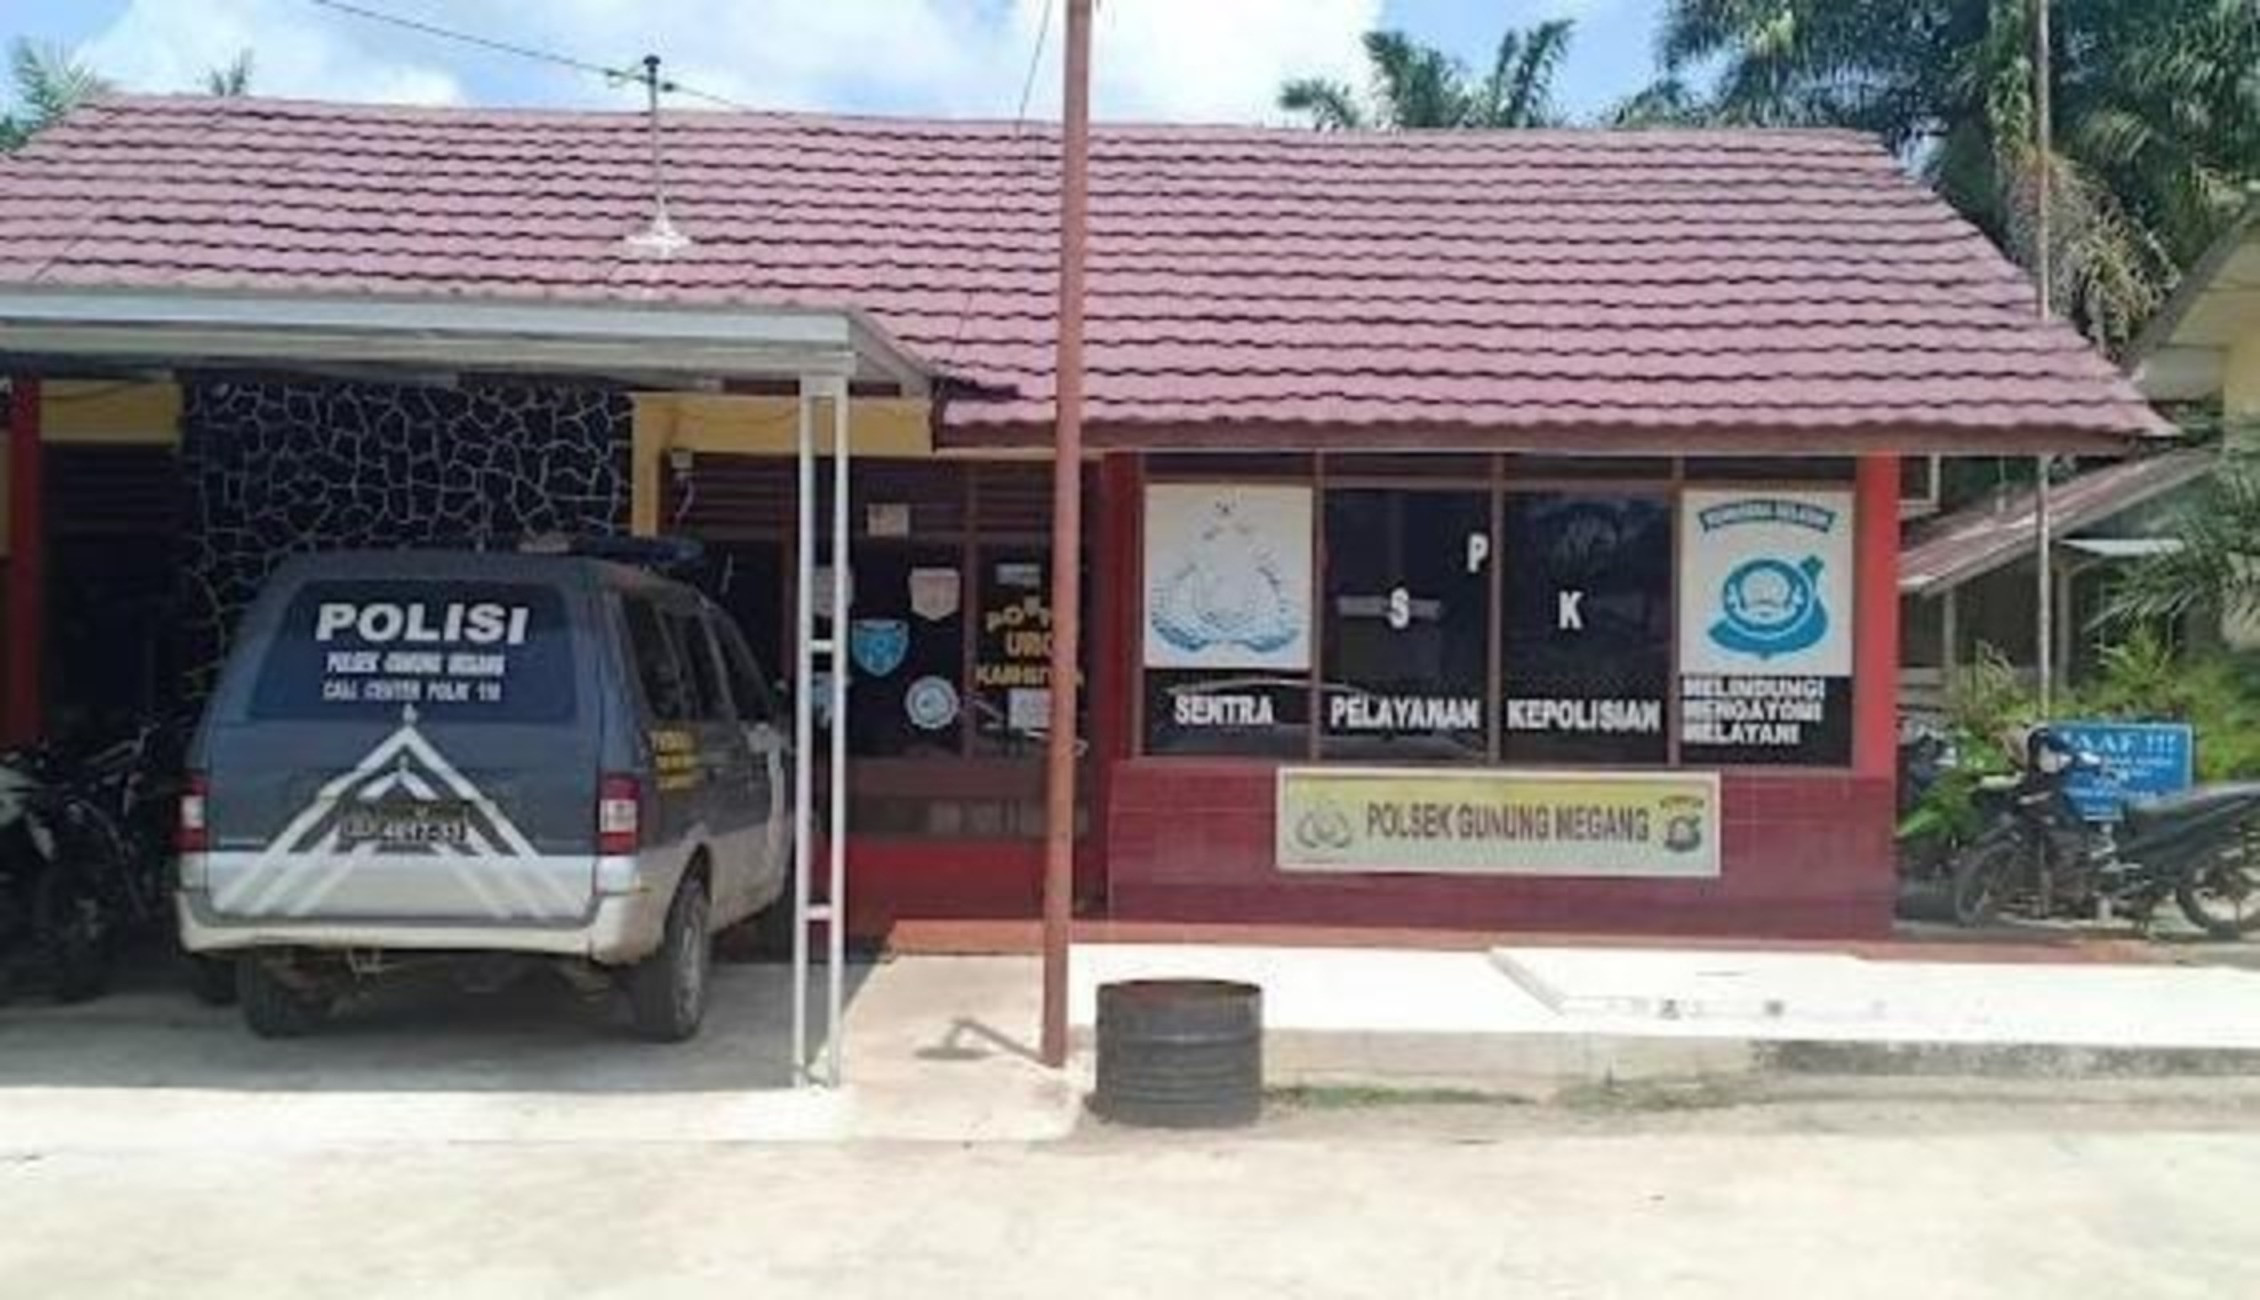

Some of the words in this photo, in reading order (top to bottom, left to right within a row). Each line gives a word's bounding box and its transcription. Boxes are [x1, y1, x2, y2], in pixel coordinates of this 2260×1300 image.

[1389, 587, 1409, 629] S
[1467, 532, 1489, 573] P
[1558, 590, 1584, 630] K
[315, 602, 529, 645] POLISI
[1174, 694, 1275, 726] SENTRA
[1329, 696, 1481, 730] PELAYANAN
[1506, 698, 1662, 732] KEPOLISIAN
[1366, 802, 1452, 839] POLSEK
[1457, 803, 1550, 841] GUNUNG
[1554, 805, 1649, 842] MEGANG
